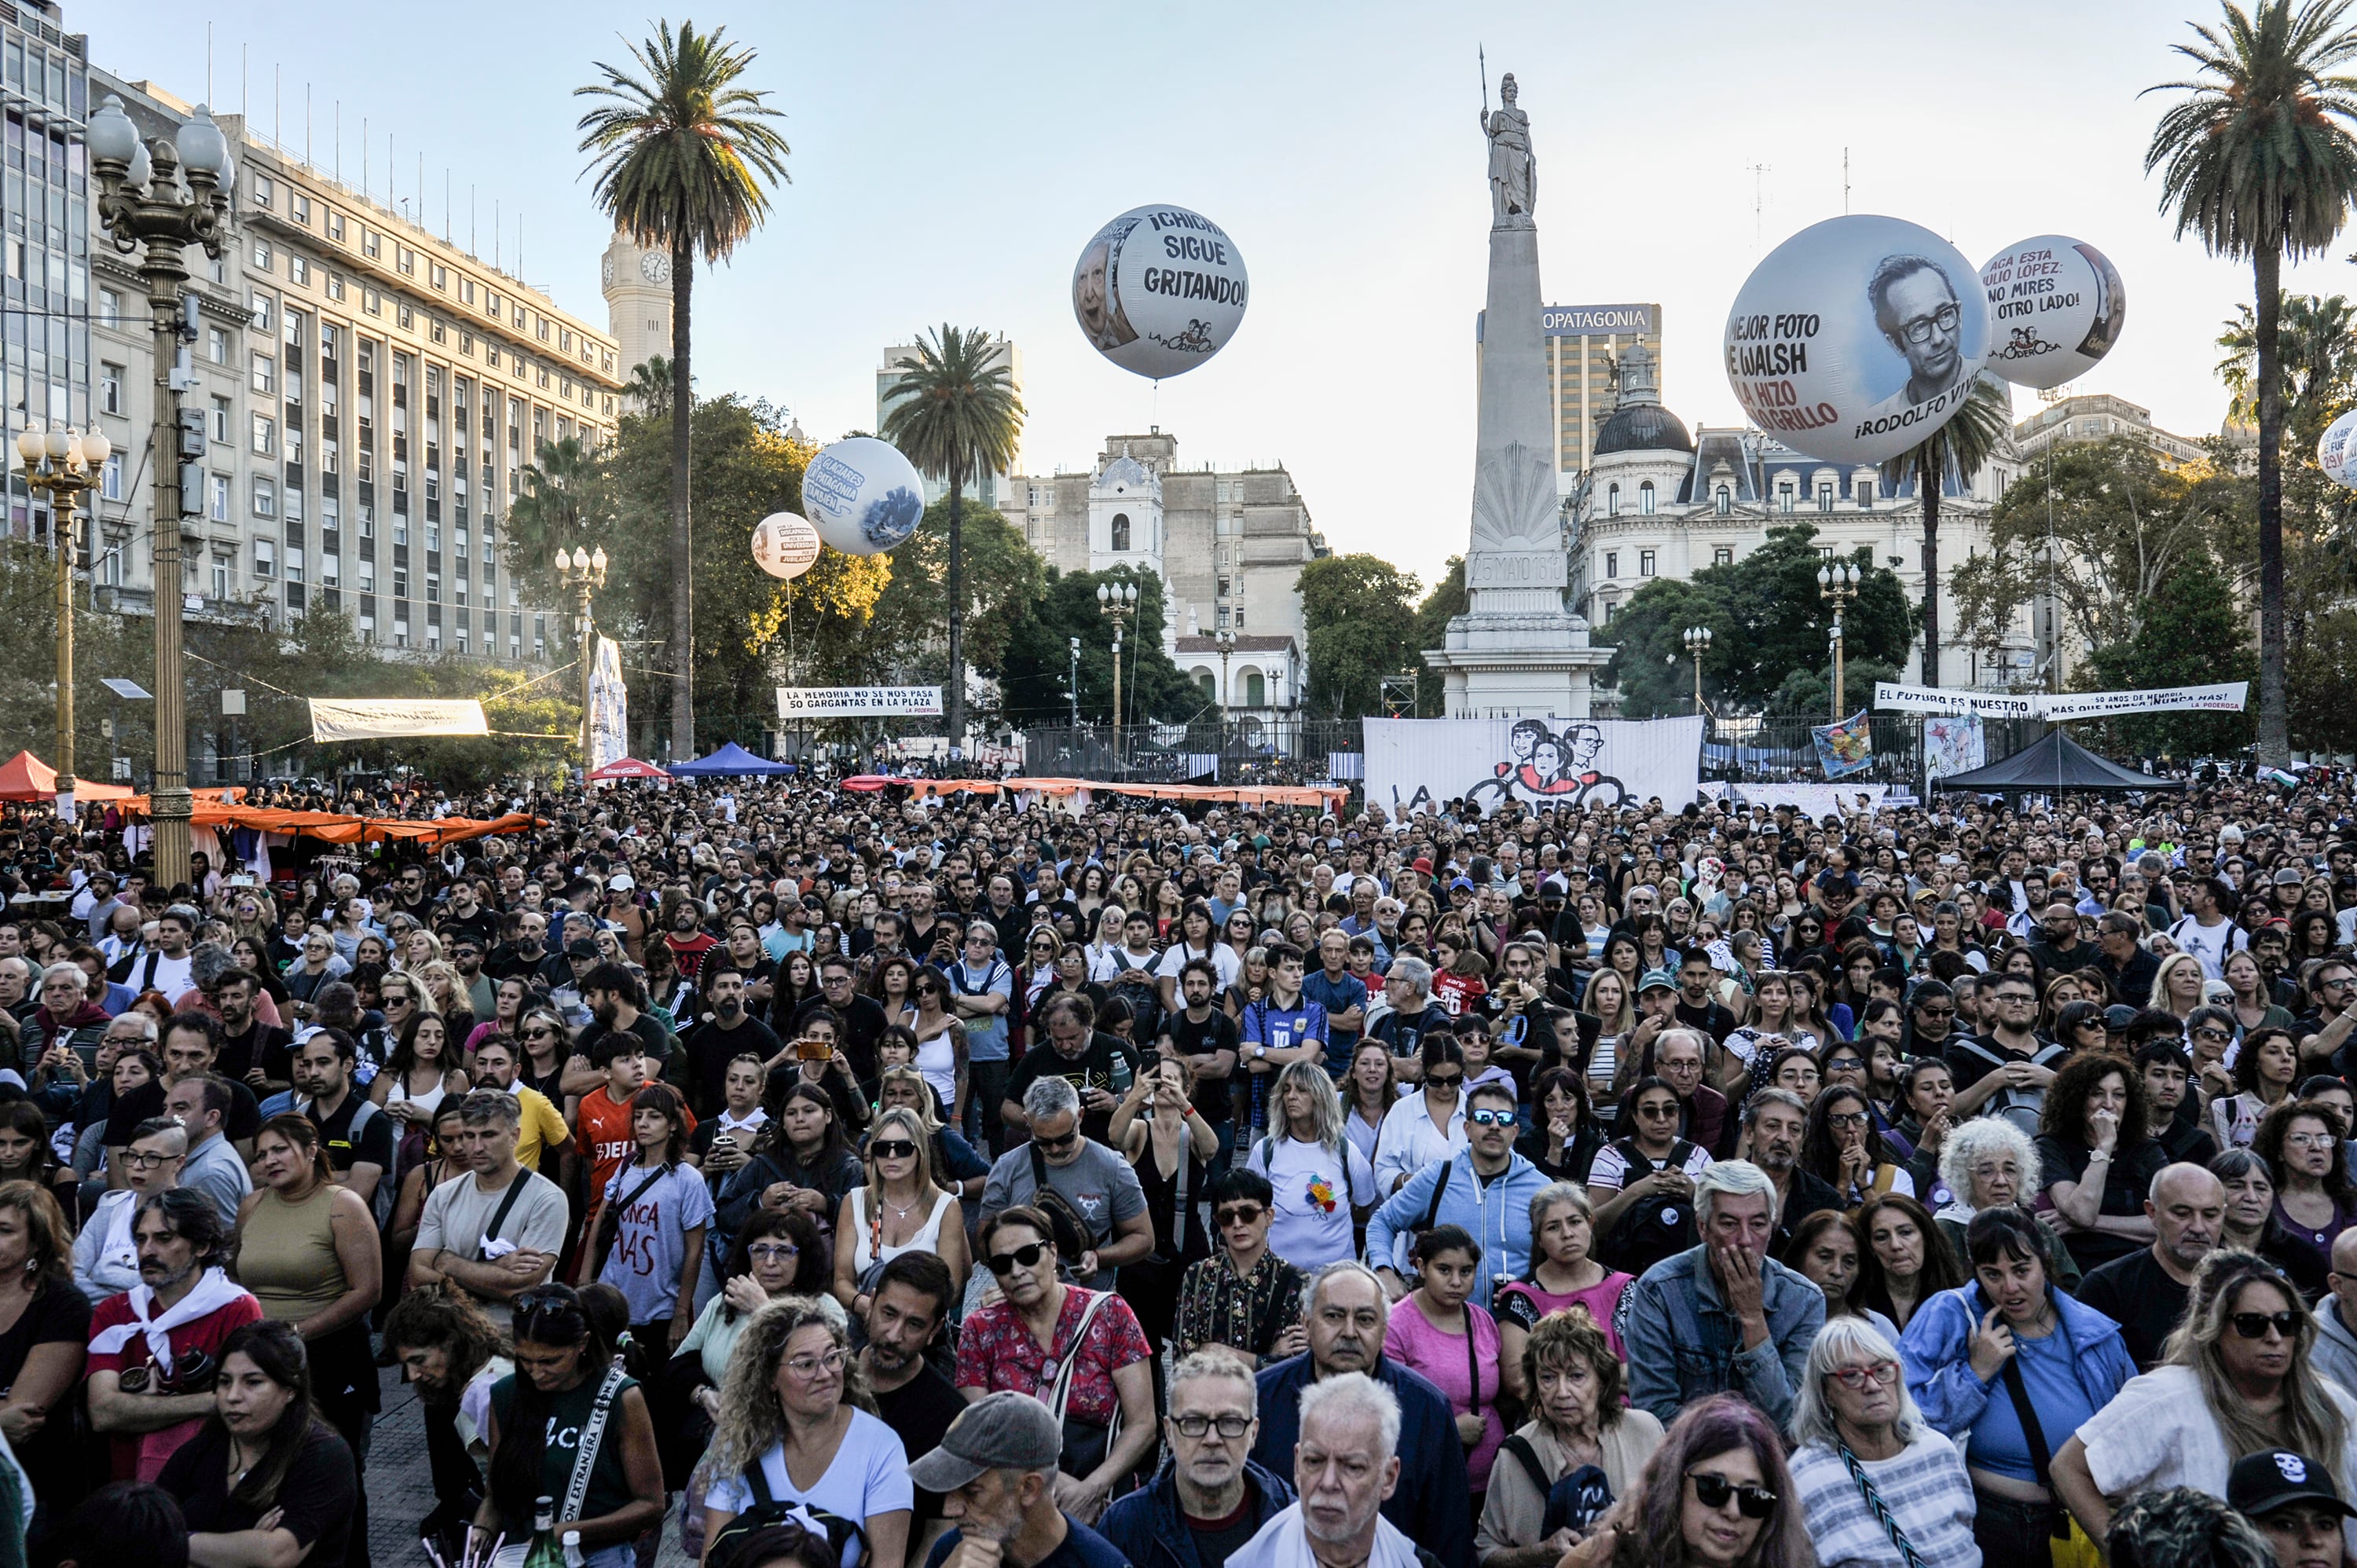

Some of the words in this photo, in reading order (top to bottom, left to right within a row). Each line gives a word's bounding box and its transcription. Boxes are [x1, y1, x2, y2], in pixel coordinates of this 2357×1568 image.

[1164, 236, 1227, 266] SIGUE
[2019, 247, 2052, 264] ESTÁ
[1144, 267, 1245, 308] GRITANDO!
[1988, 287, 2005, 303] NO
[2011, 278, 2055, 299] MIRES
[1998, 299, 2033, 320] OTRO
[2040, 292, 2080, 312] LADO!
[1148, 332, 1161, 342] LA
[1774, 313, 1820, 339] FOTO
[1740, 343, 1807, 376] WALSH
[1999, 340, 2062, 361] PODEROSA
[1754, 379, 1797, 408] HIZO
[1854, 395, 1947, 438] ¡RODOLFO
[823, 456, 864, 486] GLACIARES
[816, 470, 857, 501] PATAGONIA
[1495, 556, 1530, 581] MAYO
[790, 700, 803, 709] 50
[808, 698, 867, 708] GARGANTAS
[904, 698, 931, 706] PLAZA
[1879, 690, 1892, 699] EL
[1897, 691, 1946, 704] FUTURO
[1951, 698, 1965, 706] ES
[1970, 699, 2029, 712] NUESTRO
[603, 767, 642, 775] Coca-Cola
[1273, 1030, 1290, 1048] 10
[571, 1432, 598, 1500] EXTRANJERA
